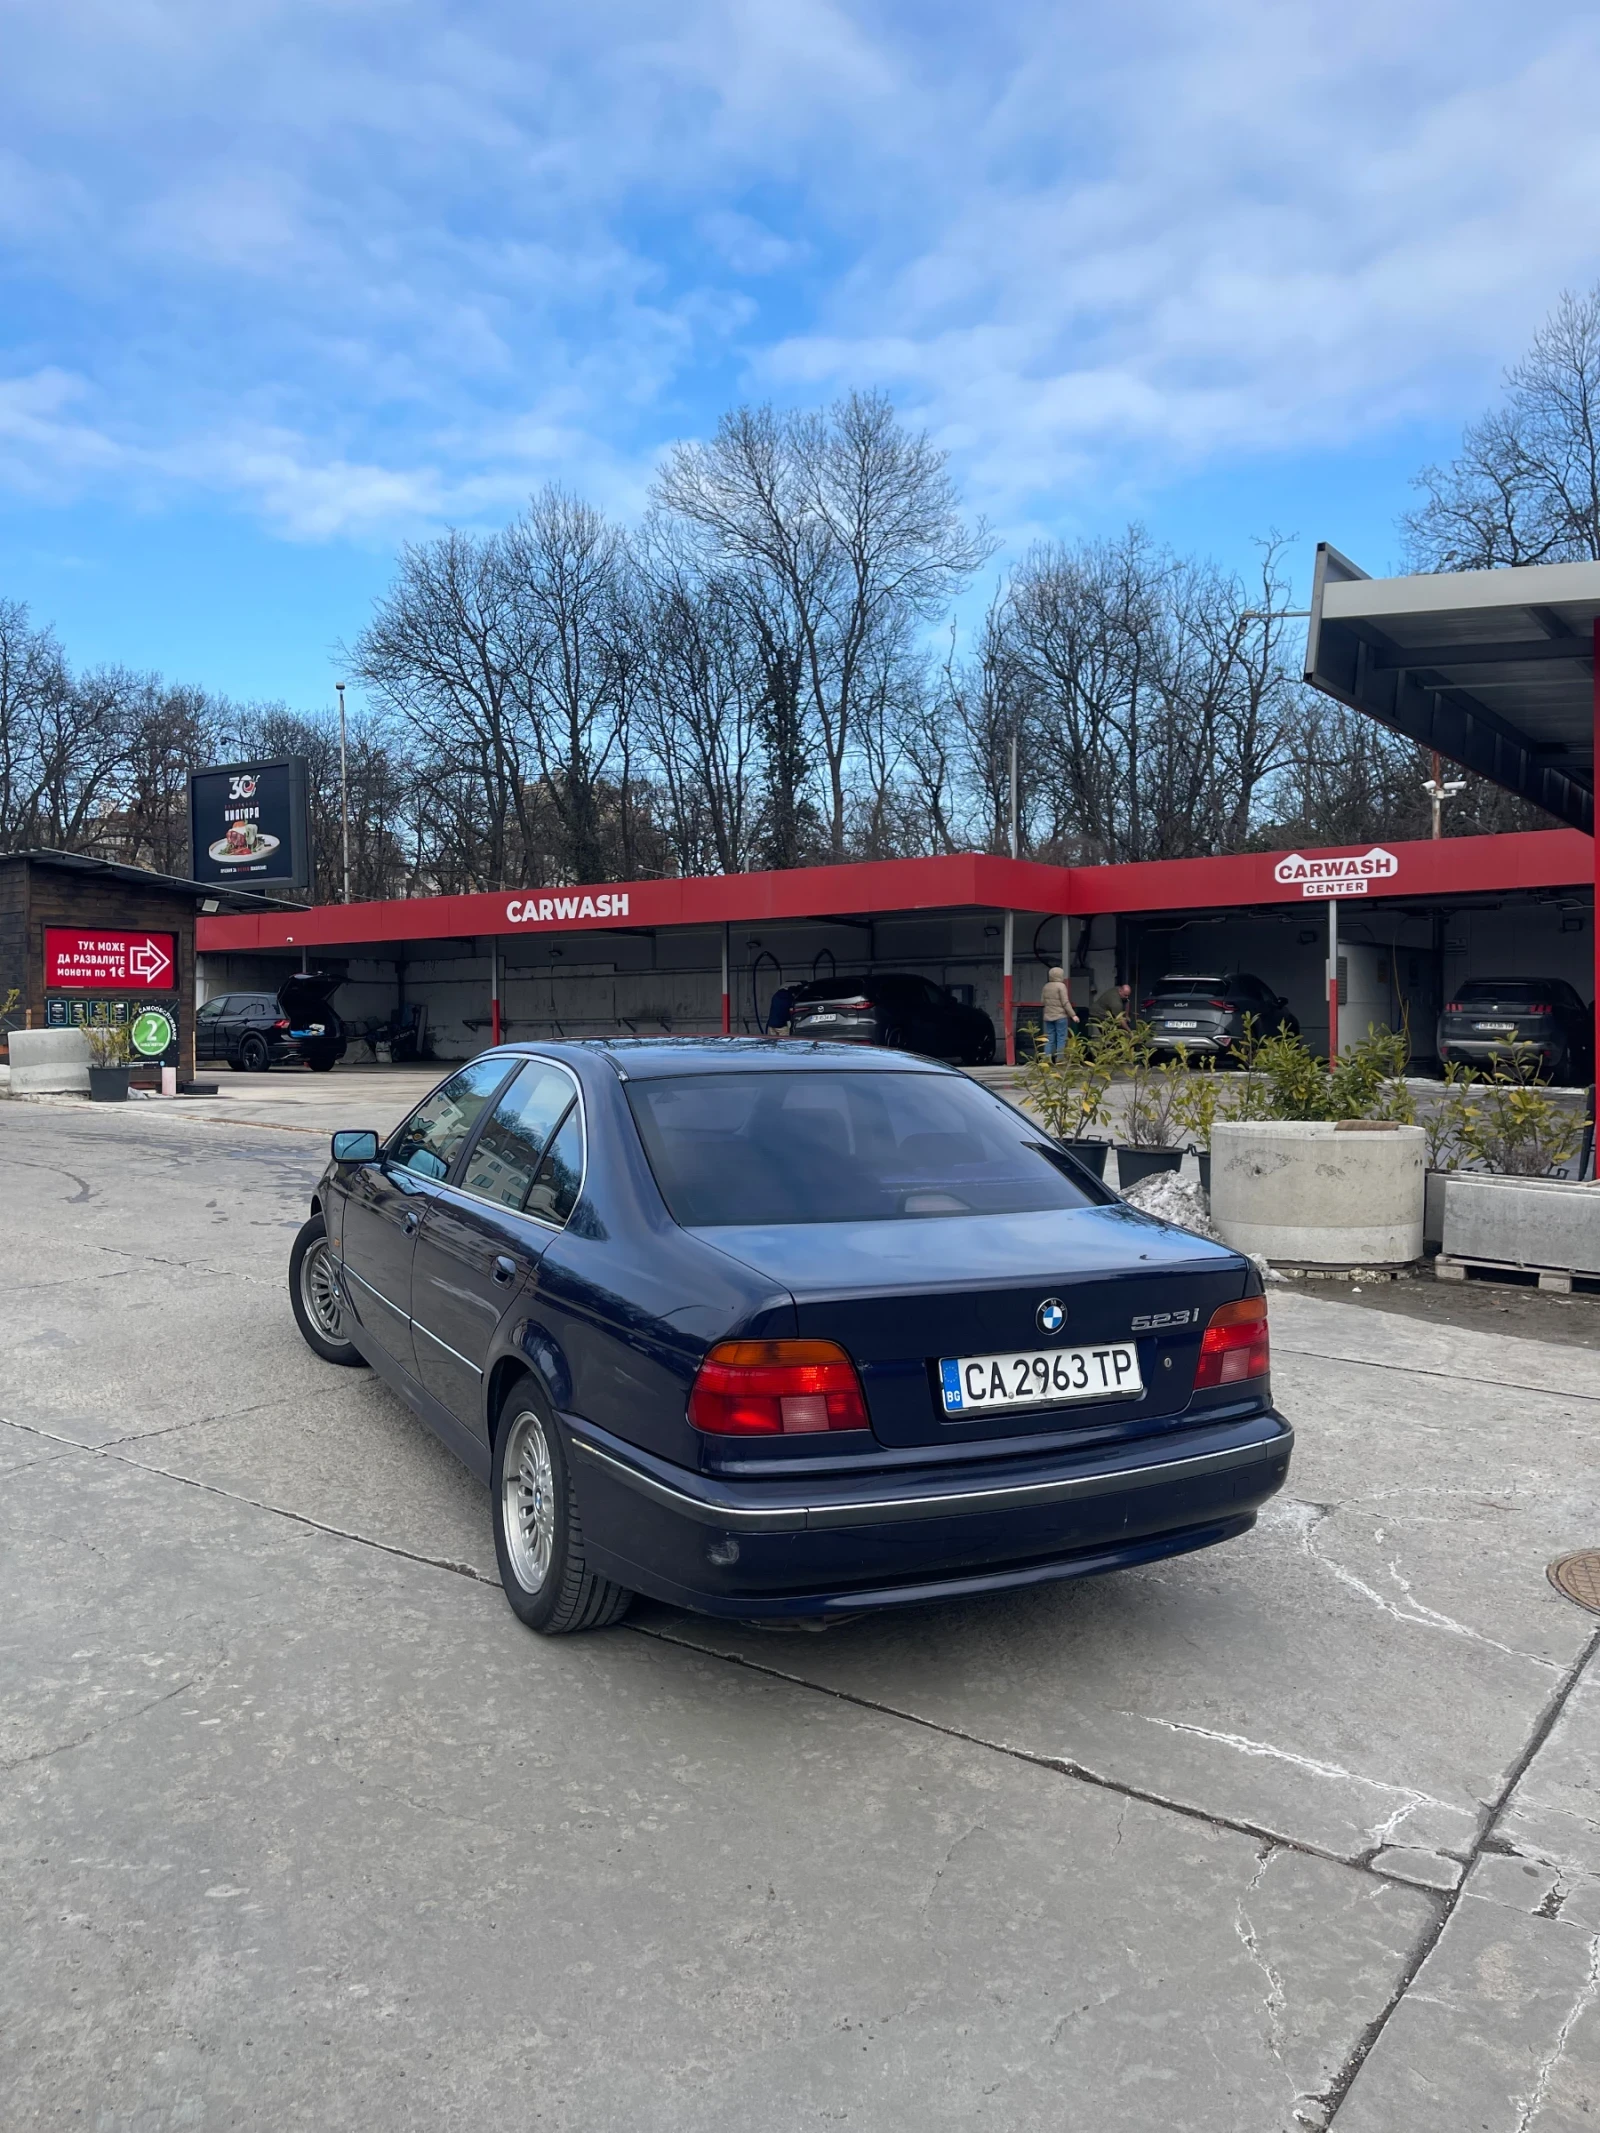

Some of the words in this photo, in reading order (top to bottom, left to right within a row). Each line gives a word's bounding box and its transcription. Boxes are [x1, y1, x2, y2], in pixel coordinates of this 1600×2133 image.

[1278, 858, 1391, 880] CARWASH
[1306, 882, 1364, 894] CENTER
[506, 893, 629, 923] CARWASH
[77, 941, 95, 951] ТУК
[97, 942, 125, 952] МОЖЕ
[57, 954, 71, 964] ДА
[73, 954, 125, 965] РАЗВАЛИТЕ
[57, 968, 92, 977] монети
[94, 969, 106, 977] по
[109, 966, 125, 977] 1€
[146, 1019, 158, 1042] 2
[1040, 1299, 1066, 1312] BMW
[1130, 1307, 1200, 1331] 523i
[946, 1390, 961, 1402] BG
